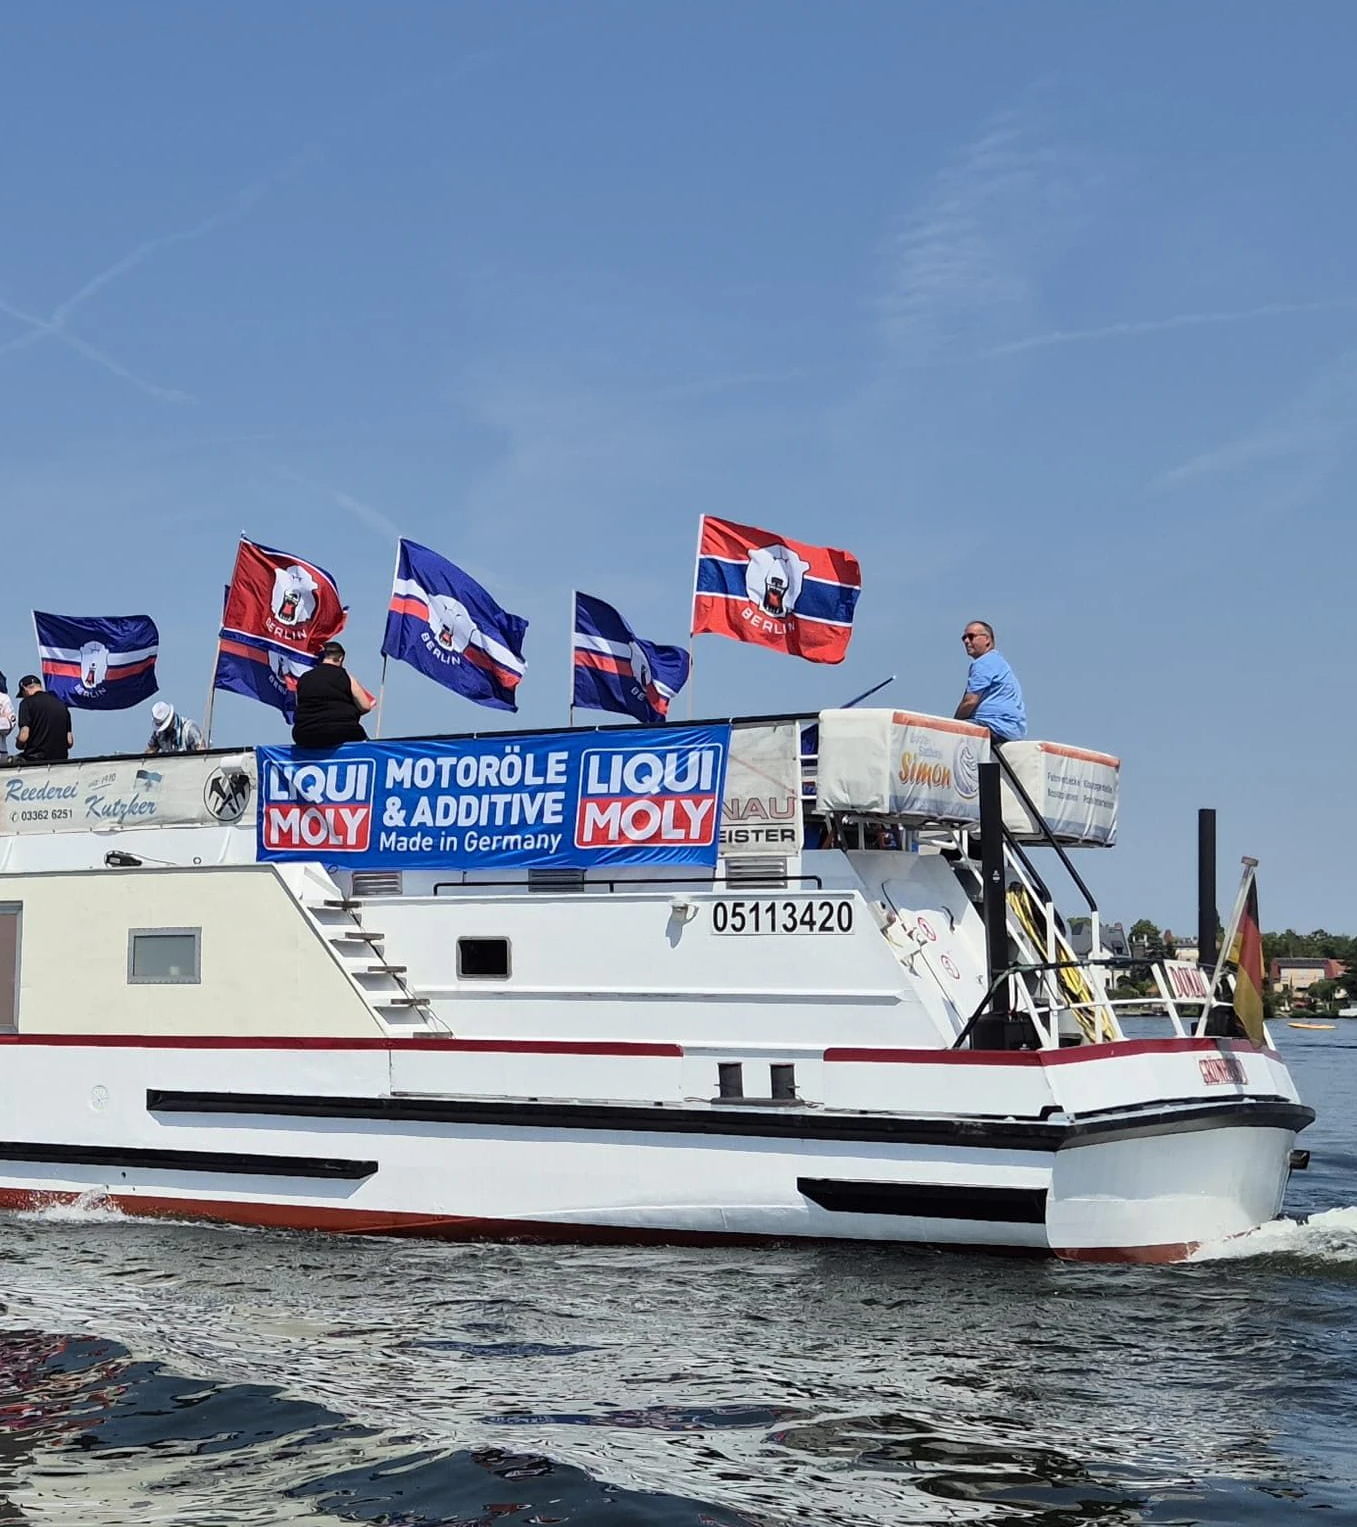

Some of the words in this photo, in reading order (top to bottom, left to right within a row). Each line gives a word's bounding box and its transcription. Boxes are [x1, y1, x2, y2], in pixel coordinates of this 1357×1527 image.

[265, 616, 307, 640] BERLIN
[742, 607, 795, 634] BERLIN
[420, 632, 461, 665] BERLIN
[385, 745, 568, 789] MOTORÖLE
[586, 750, 714, 795] LIQUI
[898, 751, 952, 790] Simon
[4, 779, 79, 803] Reederei
[20, 810, 49, 821] 03362
[51, 808, 73, 820] 6251
[84, 793, 157, 824] Kutzker
[382, 797, 406, 827] &
[410, 791, 564, 827] ADDITIVE
[582, 799, 714, 842] MOLY
[269, 806, 368, 845] MOLY
[379, 831, 433, 852] Made
[439, 831, 457, 852] in
[463, 832, 562, 854] Germany
[713, 901, 853, 933] 05113420
